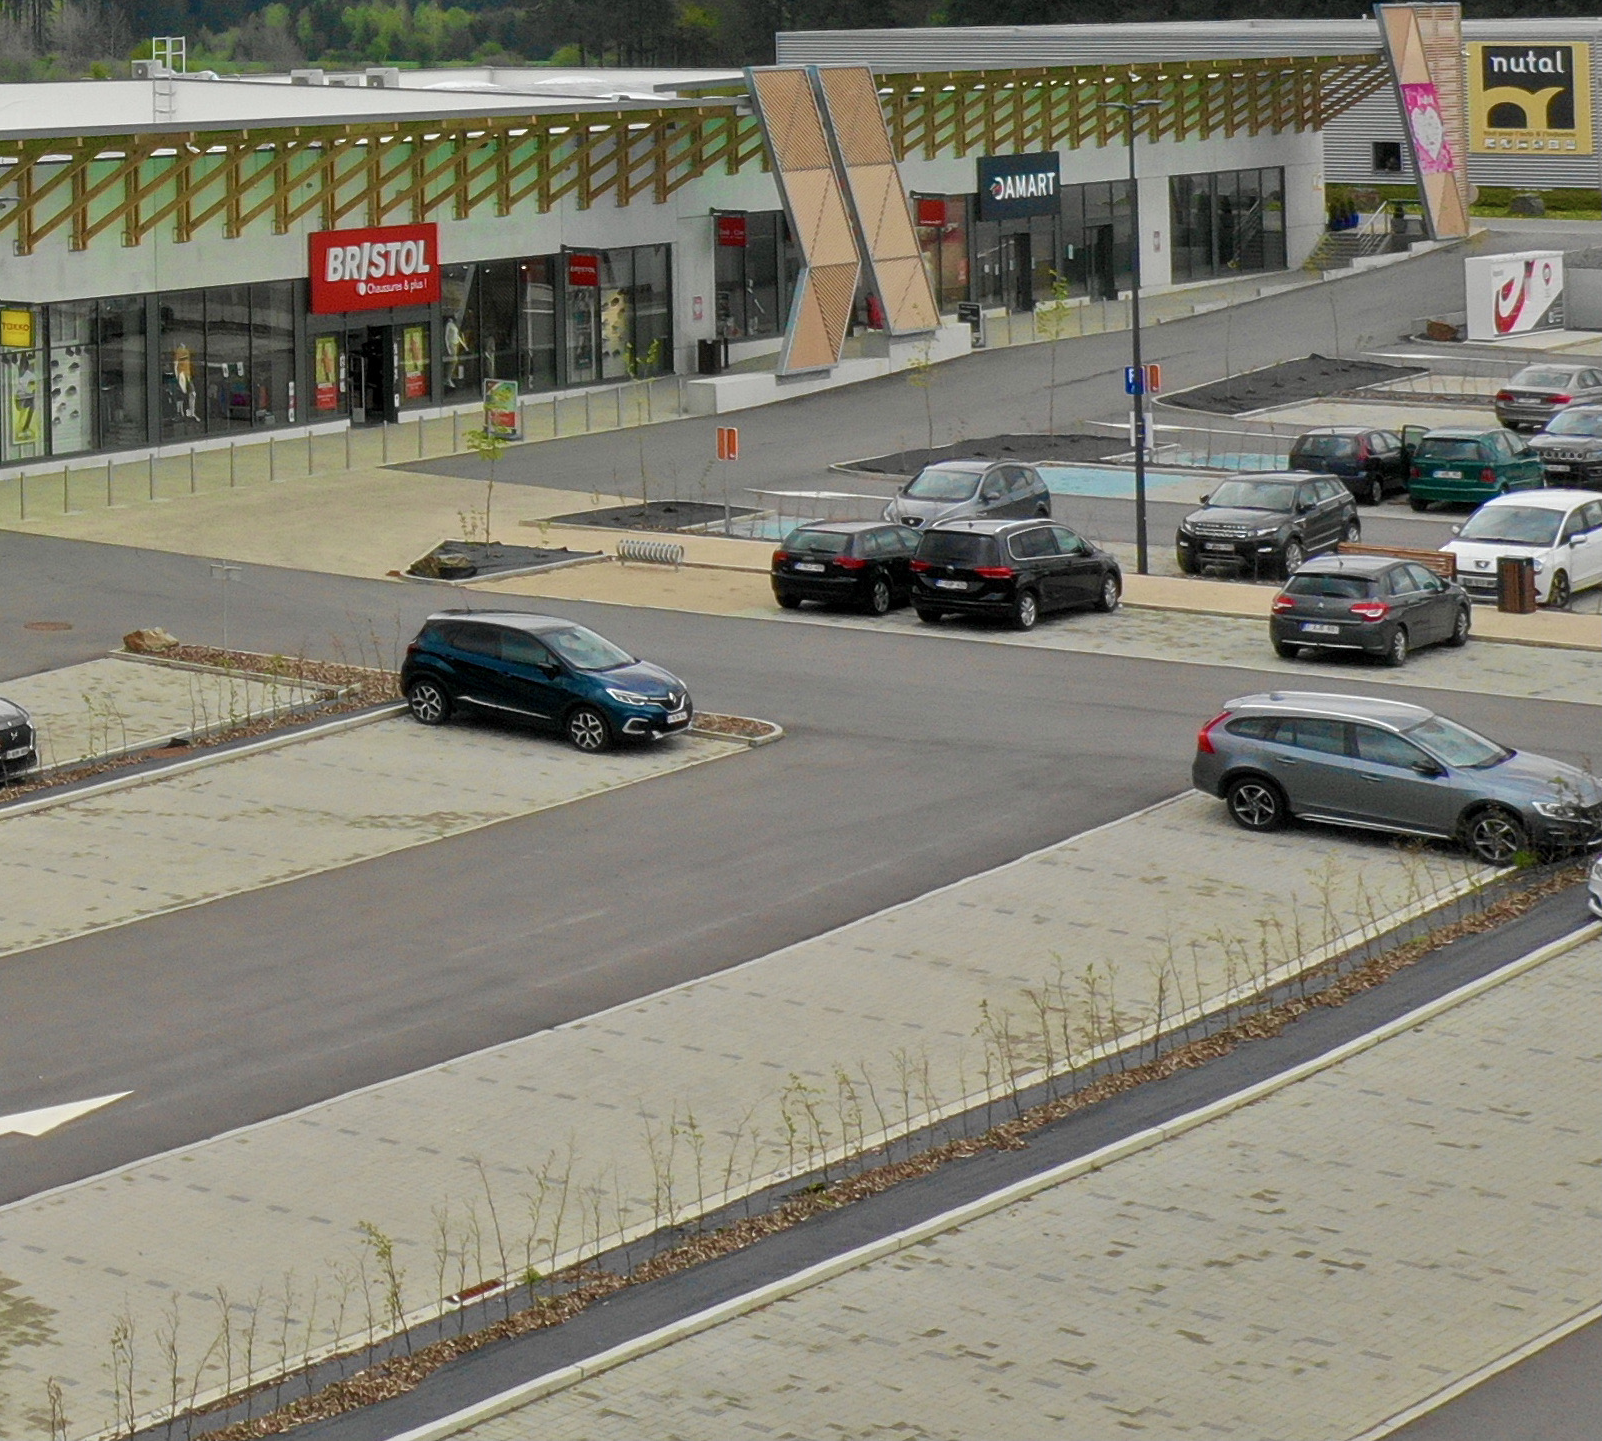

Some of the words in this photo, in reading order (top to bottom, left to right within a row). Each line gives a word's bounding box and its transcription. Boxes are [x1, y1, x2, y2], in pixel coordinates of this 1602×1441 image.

[1490, 50, 1565, 74] nutal
[990, 172, 1056, 200] DAMART
[326, 240, 430, 282] BRISTOL
